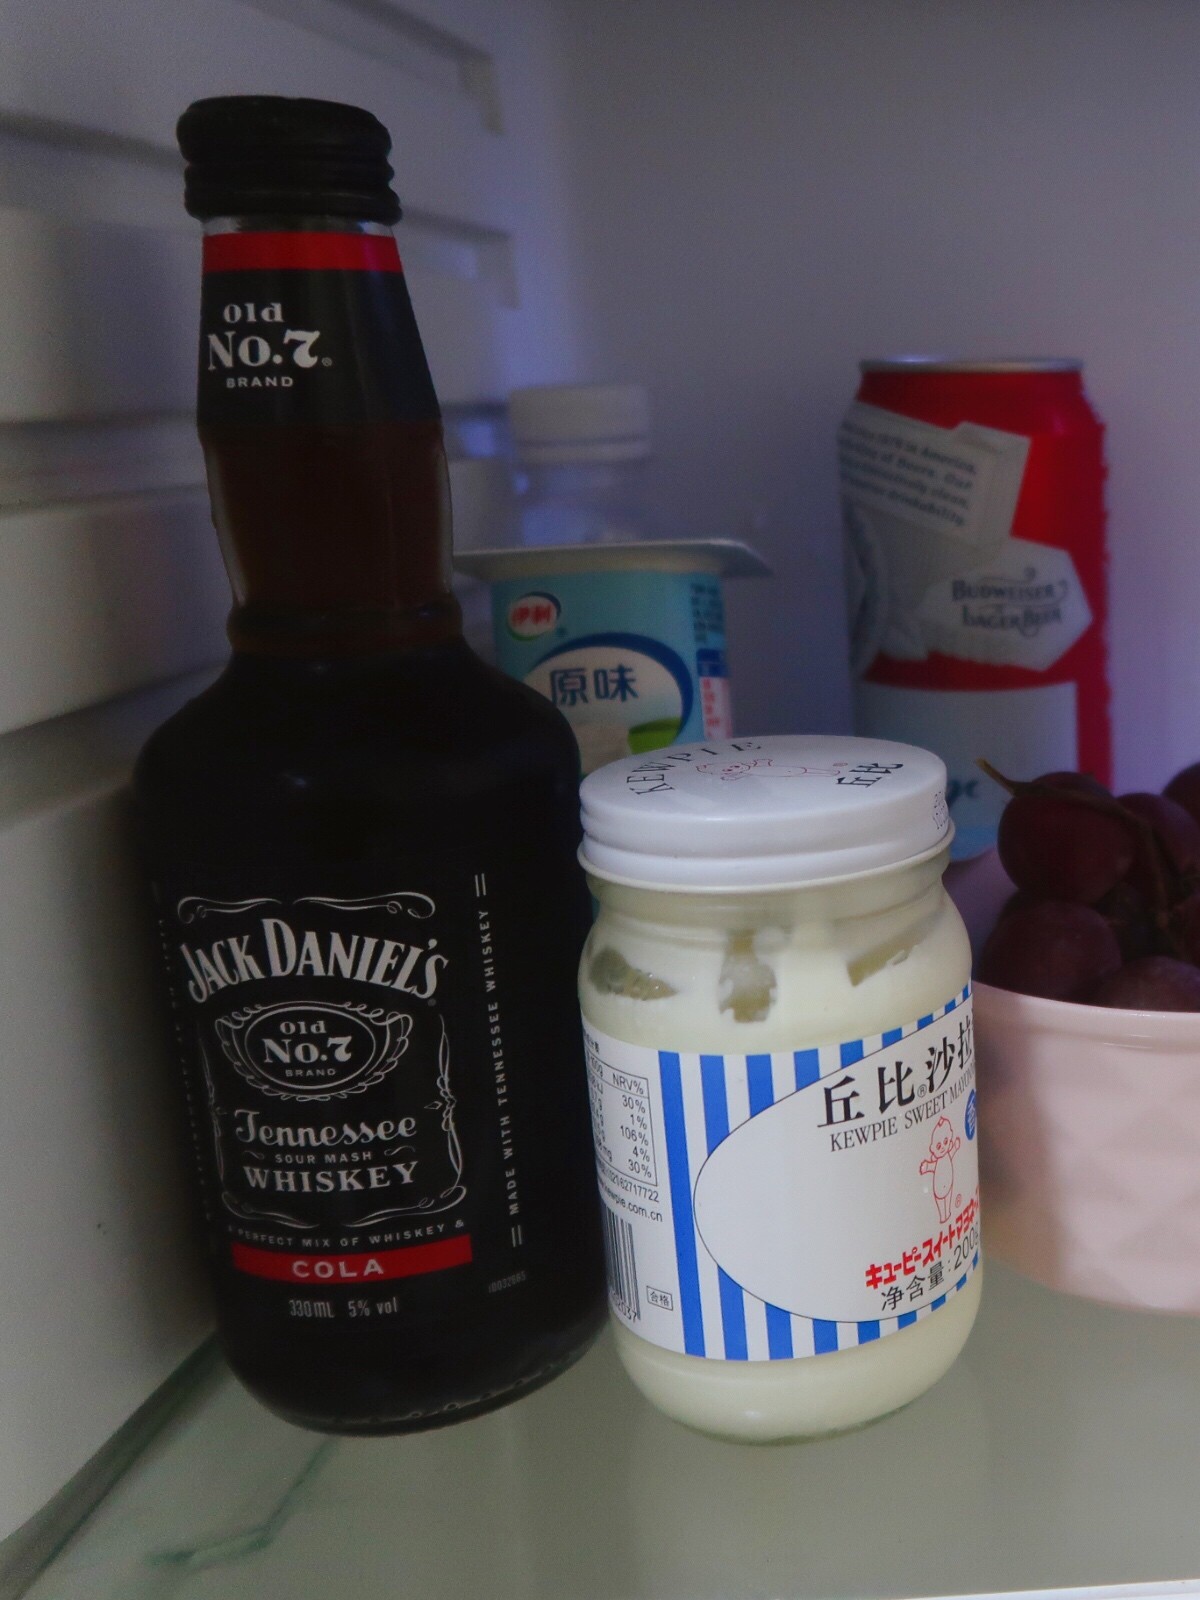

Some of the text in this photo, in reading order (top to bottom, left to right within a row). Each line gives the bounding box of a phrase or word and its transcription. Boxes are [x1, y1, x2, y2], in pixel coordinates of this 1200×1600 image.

[226, 375, 294, 388] BRAND
[550, 664, 639, 706] 原味
[627, 741, 762, 797] KEWPIE
[836, 761, 904, 790] 丘比
[181, 918, 450, 1004] JACK DANIEL'S
[285, 1068, 336, 1079] BRAND
[478, 909, 520, 1217] MADE WITH TENNESSEE WHISKEY
[612, 1072, 645, 1096] NRV%
[621, 1095, 646, 1114] 30%
[234, 1108, 418, 1148] Tennessee
[629, 1114, 648, 1131] 1%
[829, 1116, 899, 1153] KEWPIE
[904, 1091, 948, 1130] SWEET
[619, 1125, 649, 1147] 106%
[275, 1150, 374, 1165] SOUR MASH
[632, 1145, 651, 1163] 4%
[244, 1160, 419, 1194] WHISKEY
[627, 1158, 652, 1179] 30%
[238, 1229, 293, 1247] PERFECT
[302, 1238, 331, 1248] MIX
[340, 1237, 360, 1247] OF
[369, 1223, 446, 1245] WHISKEY
[291, 1258, 384, 1279] COLA
[348, 1300, 371, 1318] 5%
[376, 1297, 399, 1315] vol
[650, 1290, 671, 1307] 合格
